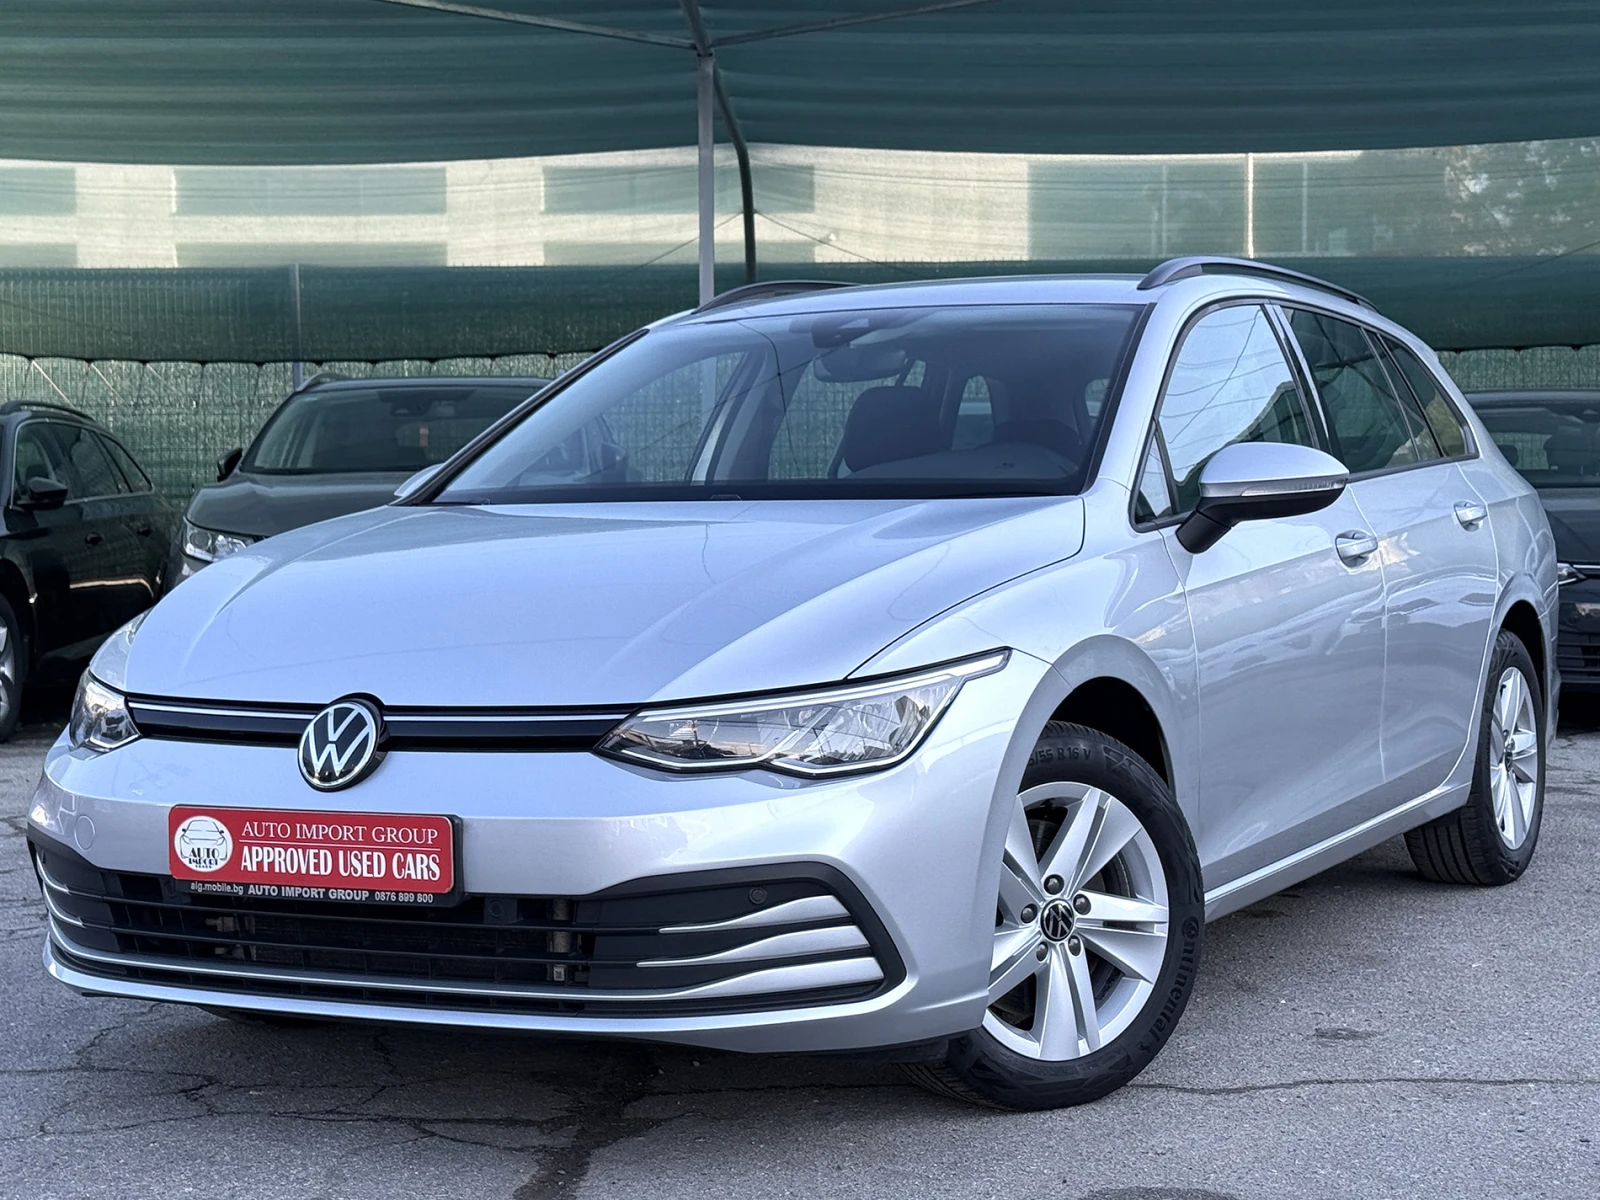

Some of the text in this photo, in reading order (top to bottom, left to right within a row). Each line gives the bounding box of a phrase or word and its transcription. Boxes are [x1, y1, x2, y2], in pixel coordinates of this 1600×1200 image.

[302, 704, 374, 782] VW
[241, 821, 439, 845] AUTO IMPORT GROUP
[189, 847, 220, 859] AUTO
[241, 845, 441, 881] APPROVED USED CARS
[248, 884, 279, 897] AUTO
[281, 887, 326, 899] IMPORT
[328, 889, 370, 901] GROUP
[374, 891, 397, 902] 0876
[398, 892, 415, 903] 899
